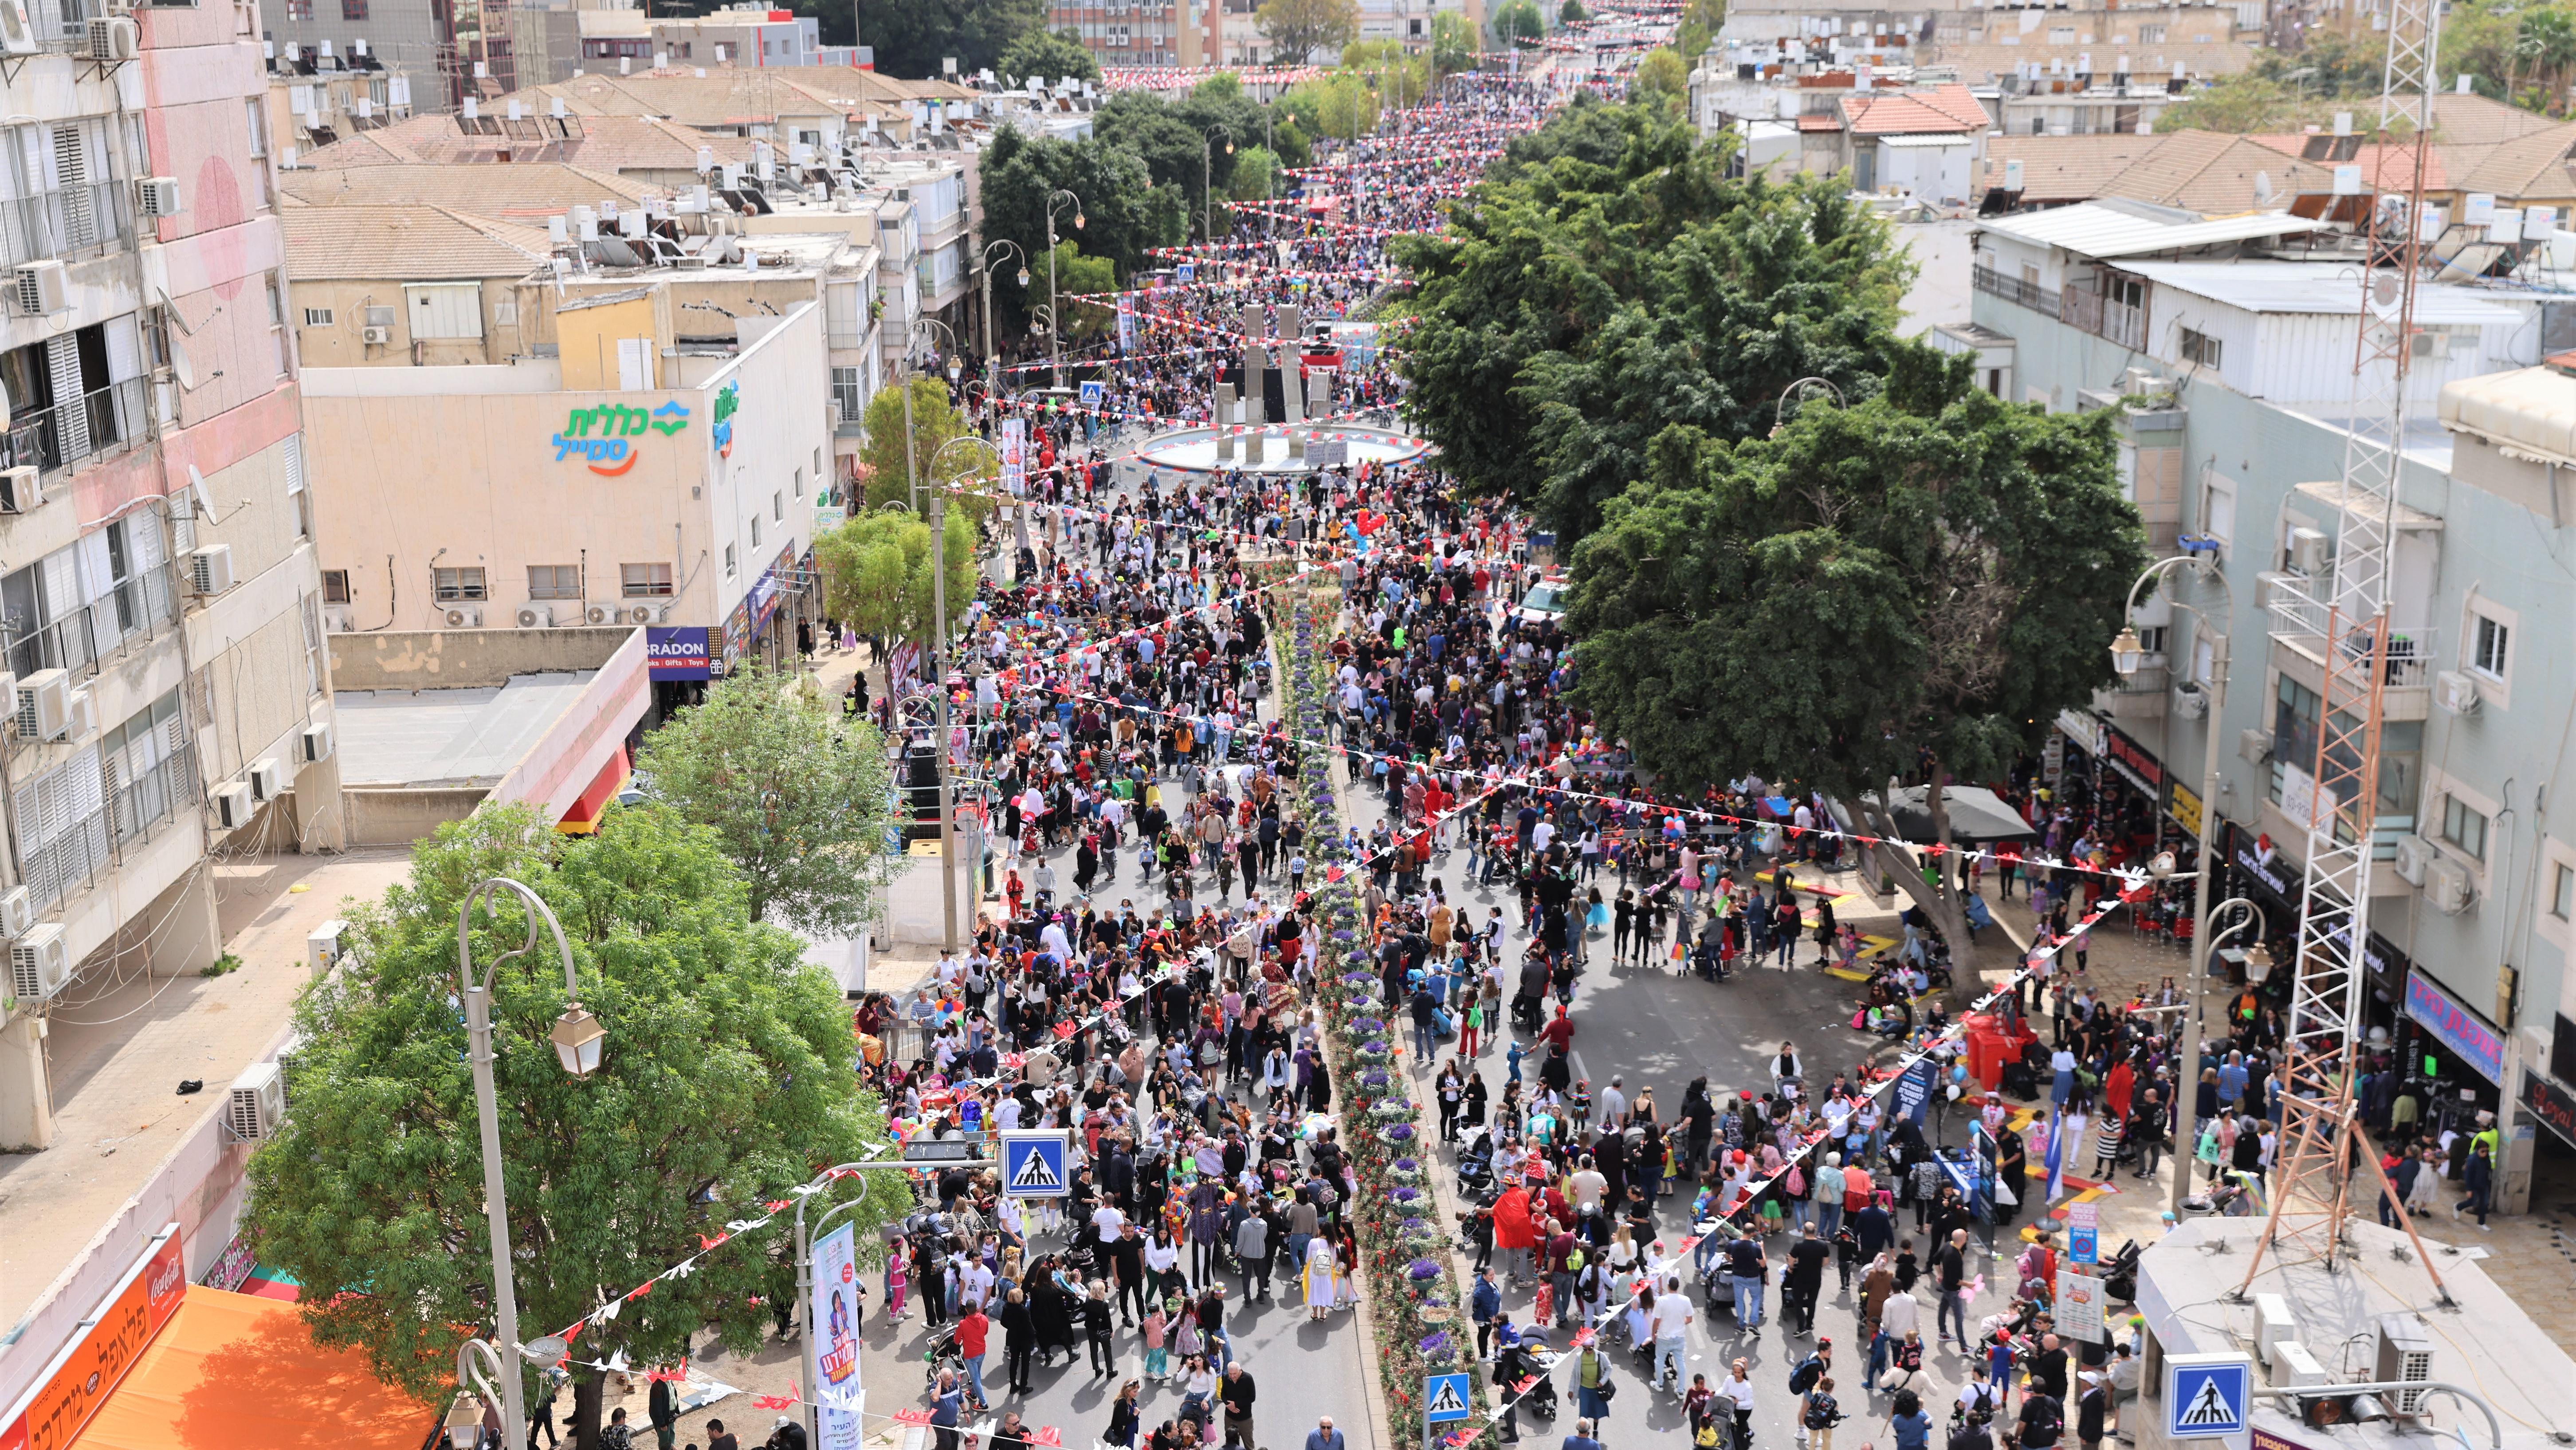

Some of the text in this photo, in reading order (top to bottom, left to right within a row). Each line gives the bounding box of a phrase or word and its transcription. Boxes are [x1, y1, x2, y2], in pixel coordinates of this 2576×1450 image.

[564, 403, 648, 436] כללית
[552, 433, 628, 461] סמייל
[2442, 1007, 2503, 1065] אופנת
[151, 1251, 180, 1306] Coca-Cola
[97, 1305, 146, 1385] פלאפל
[823, 1340, 856, 1373] עדלאידע
[833, 1336, 842, 1350] של
[86, 1373, 98, 1390] SINCE
[831, 1367, 847, 1382] תקווה
[33, 1379, 61, 1417] כשר למהדרין
[34, 1384, 83, 1450] מרדכי
